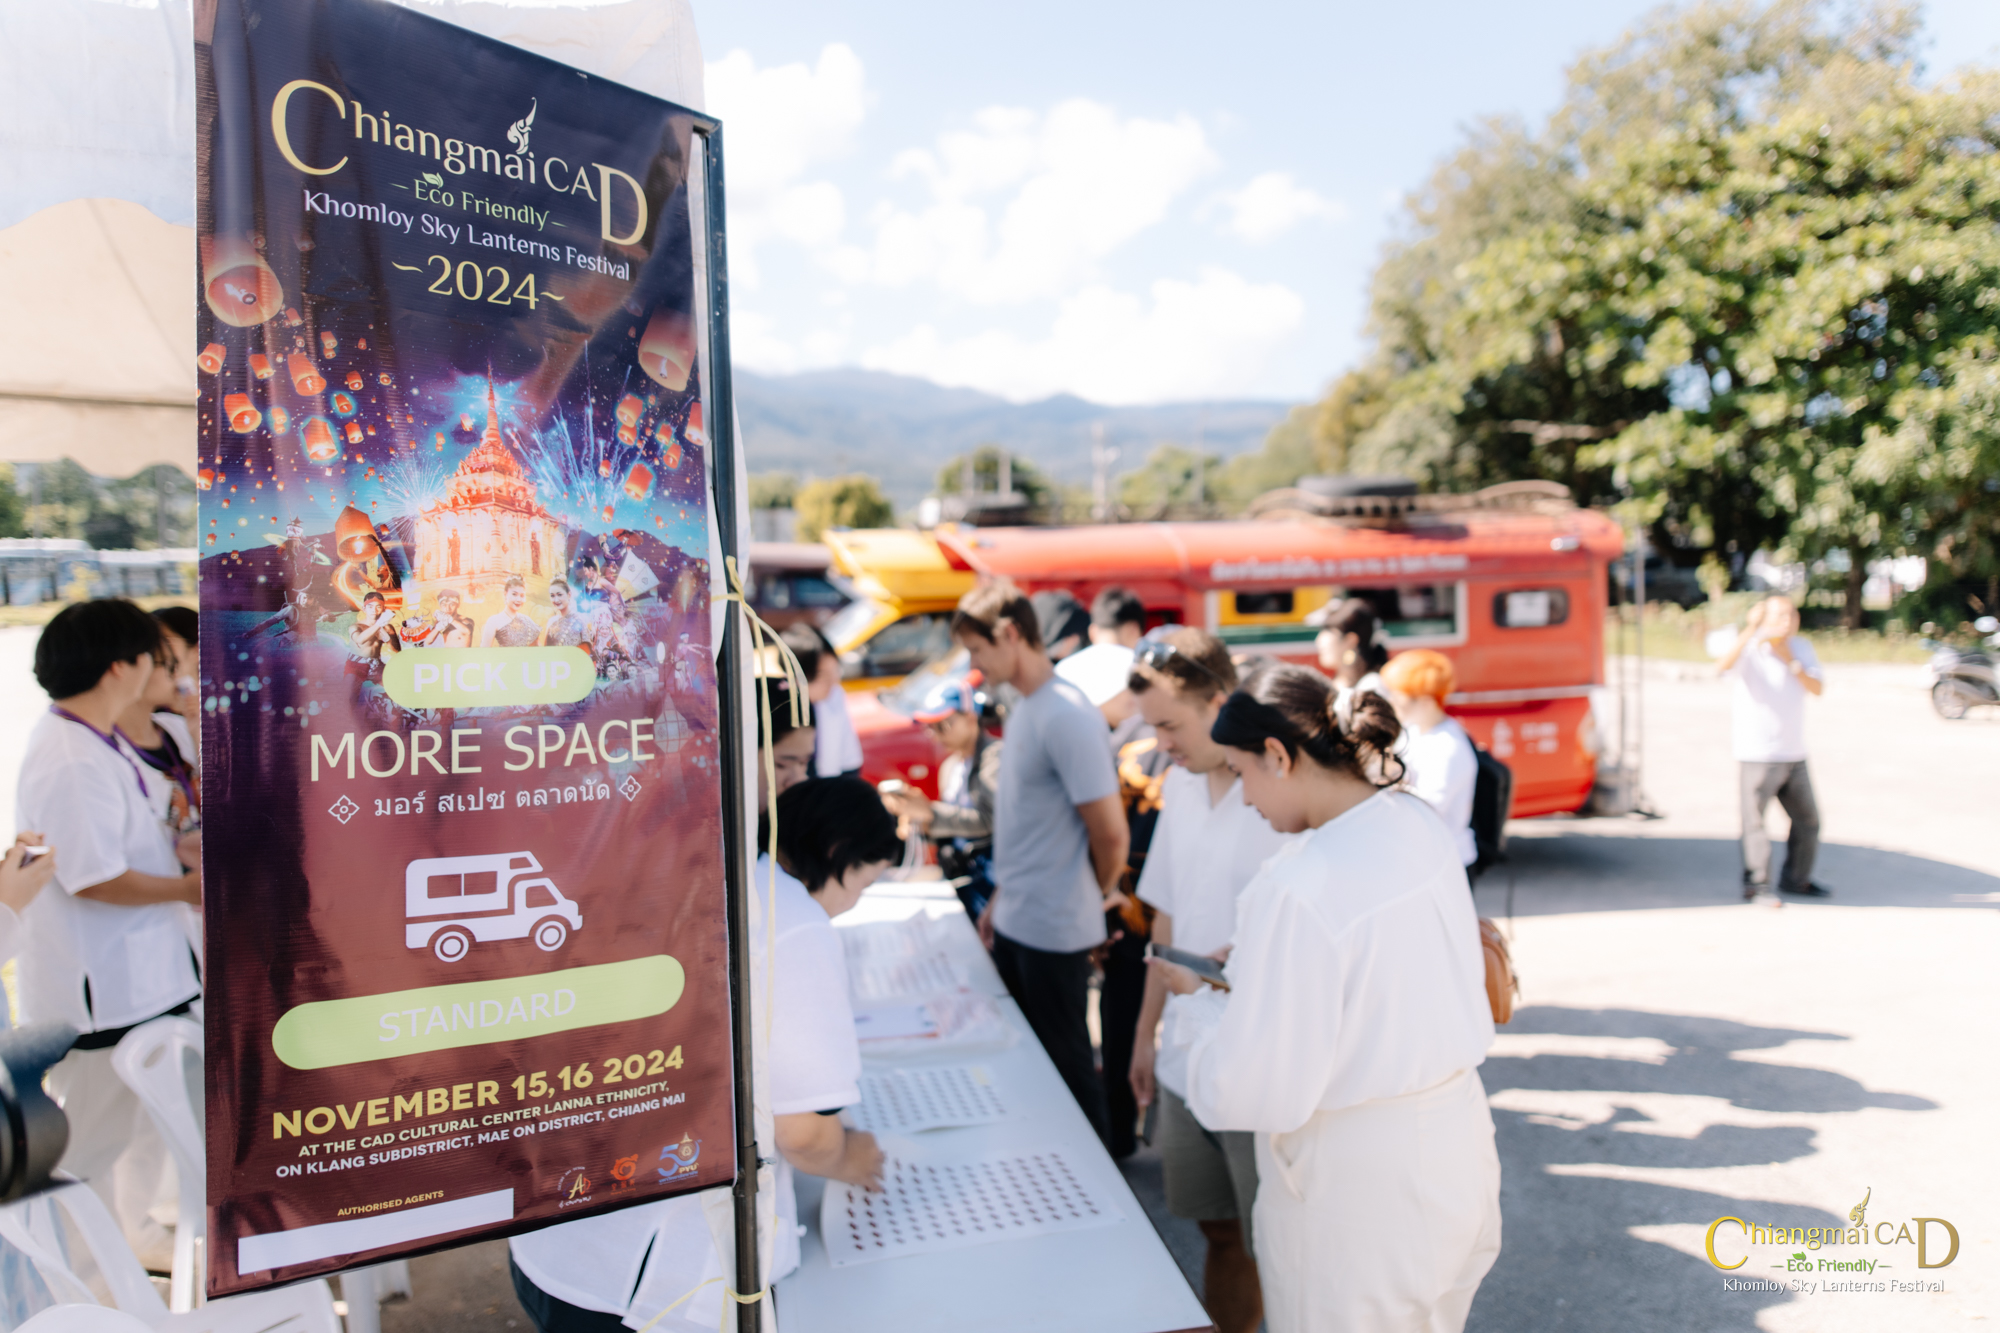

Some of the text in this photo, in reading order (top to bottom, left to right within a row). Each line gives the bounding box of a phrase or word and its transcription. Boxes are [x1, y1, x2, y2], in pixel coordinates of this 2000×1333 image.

[271, 79, 648, 246] Chiangmai CAD
[303, 189, 630, 281] Khomloy Sky Lanterns Festival
[413, 178, 550, 231] Eco Friendly
[413, 660, 572, 693] PICK UP
[310, 717, 655, 782] MORE SPACE
[374, 778, 611, 817] มอร์ สเปซ ตลาดนัด
[378, 988, 576, 1042] STANDARD
[272, 1044, 684, 1140] NOVEMBER 15,16 2024
[298, 1080, 670, 1158] AT THE CAD CULTURAL CENTER LANNA ETHNICITY,
[275, 1092, 686, 1178] ON KLANG SUBDISTRICT, MAE ON DISTRICT, CHIANG MAI
[337, 1190, 445, 1217] AUTHORISED AGENTS
